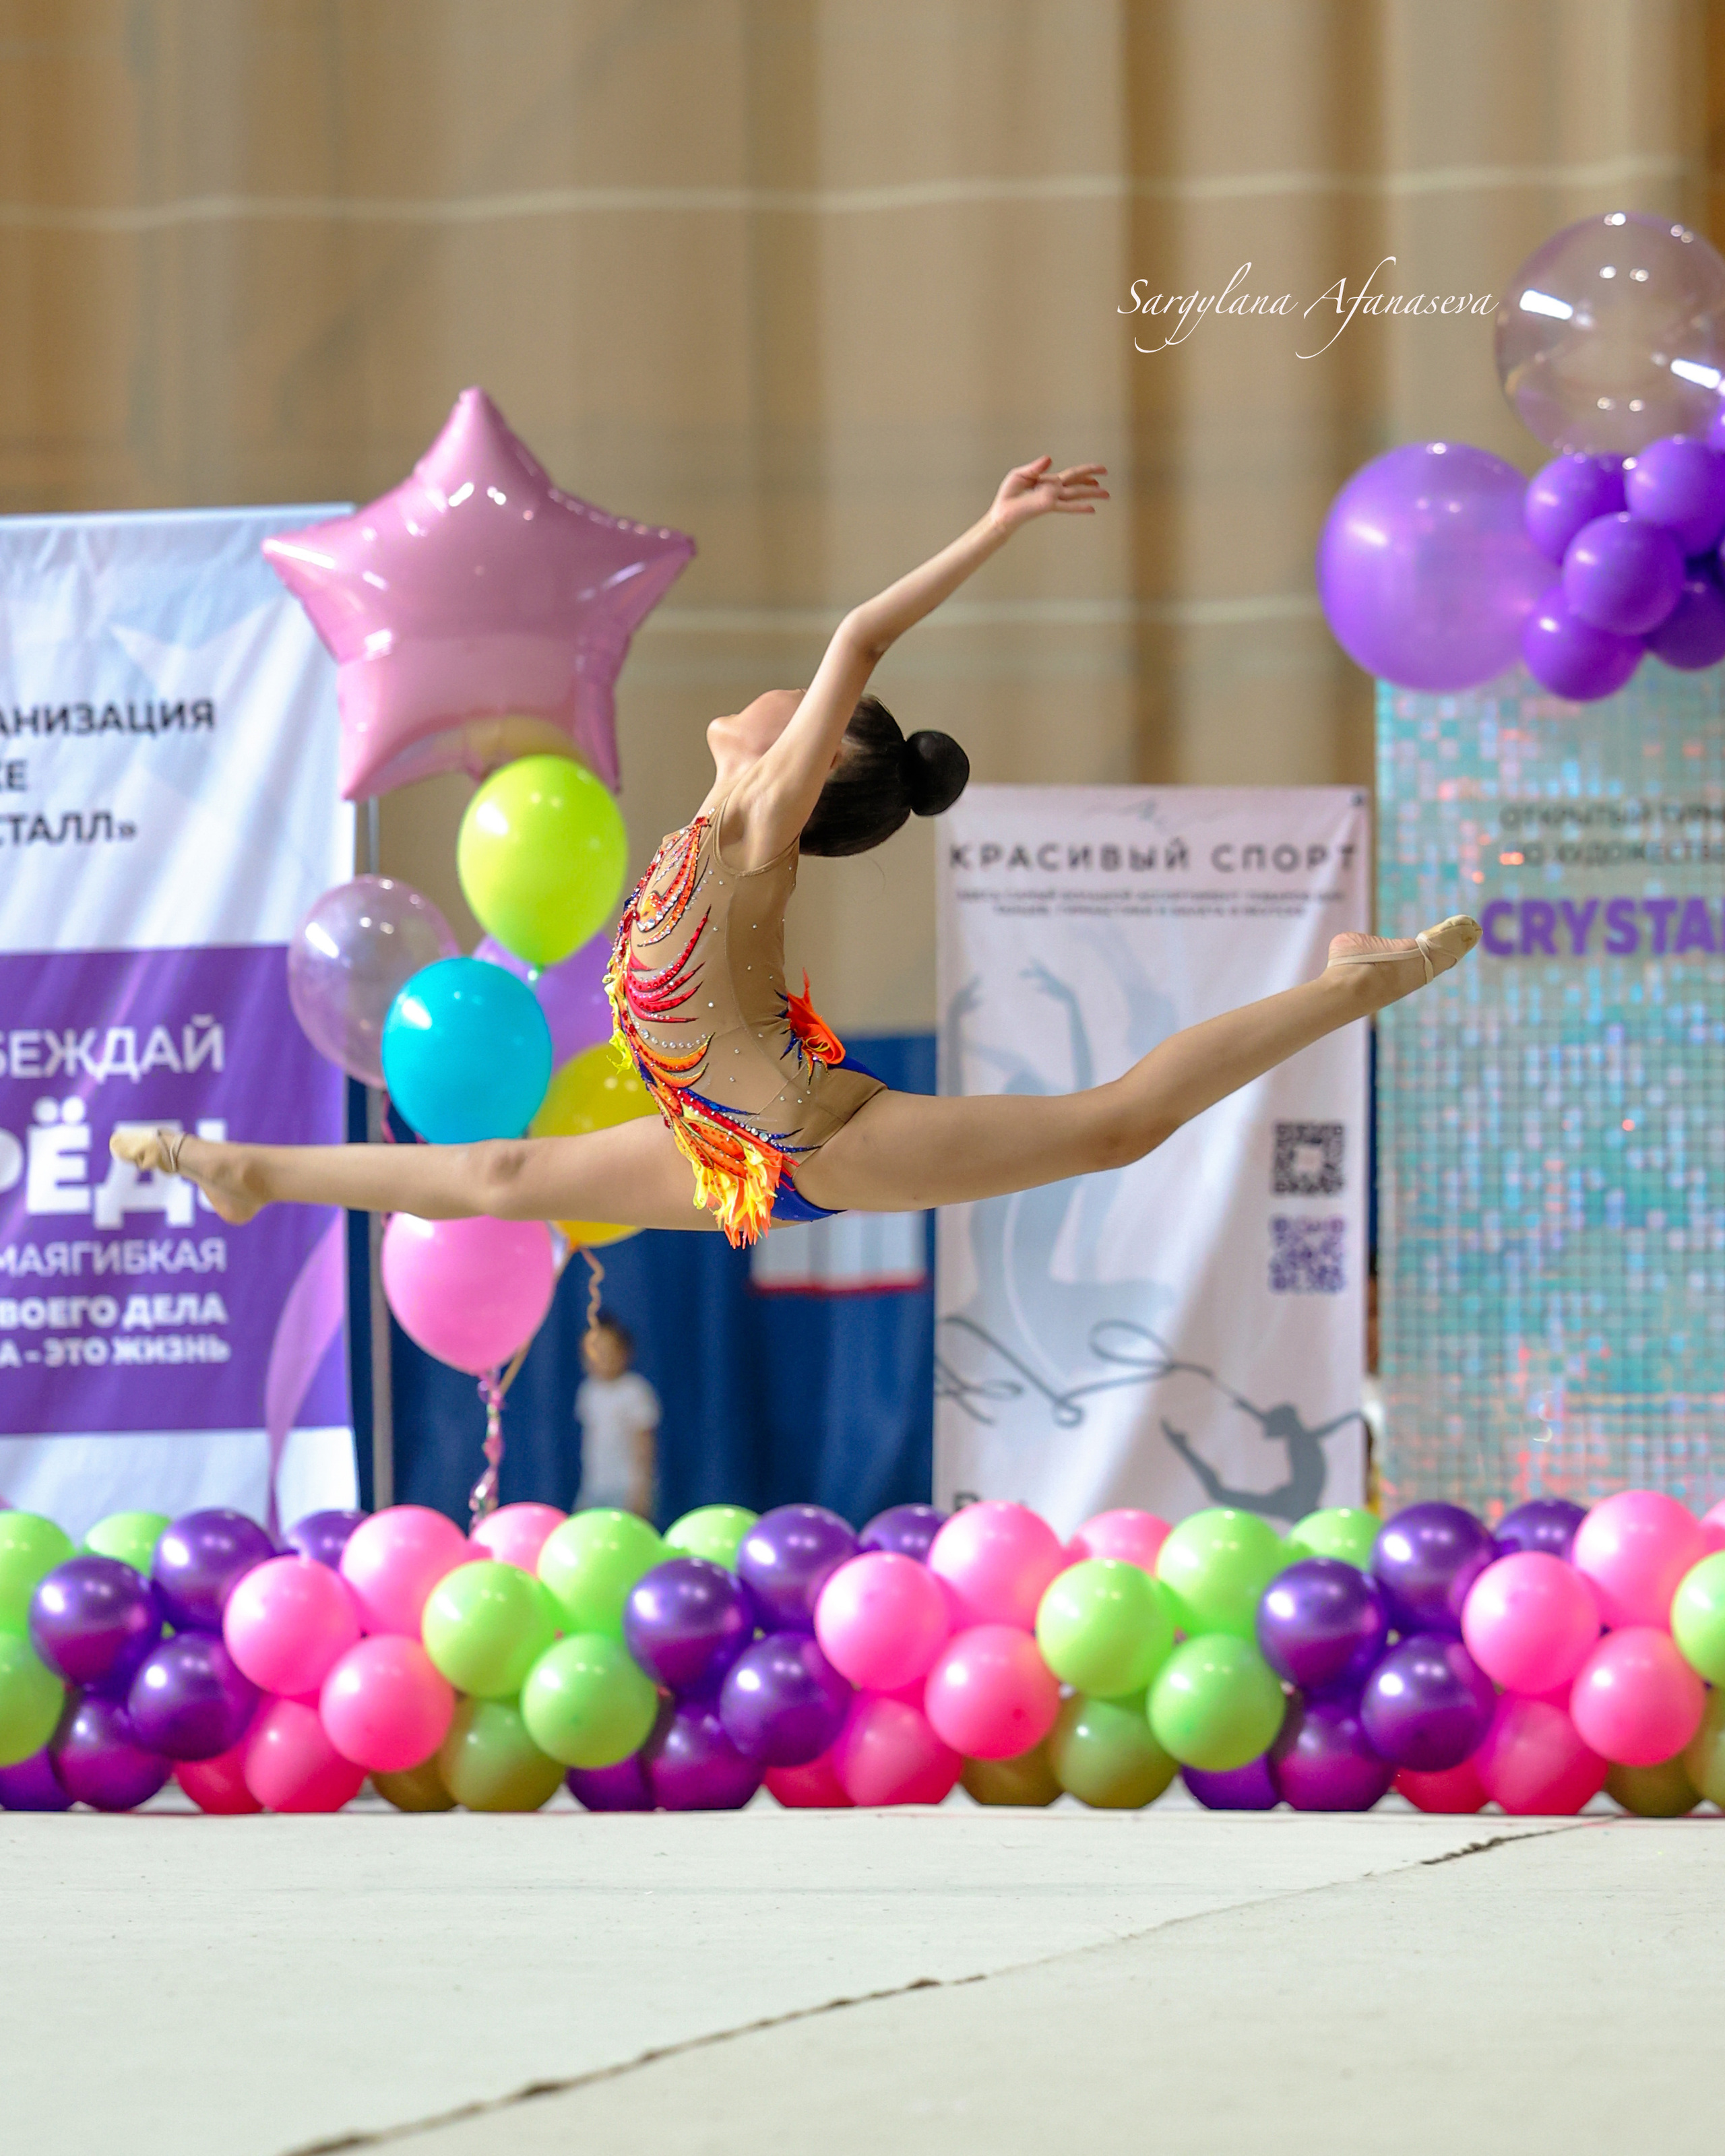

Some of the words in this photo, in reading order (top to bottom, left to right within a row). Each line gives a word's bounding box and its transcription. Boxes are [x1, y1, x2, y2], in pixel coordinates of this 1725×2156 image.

[0, 810, 137, 846] ТАЛЛ»
[949, 836, 1191, 872] КРАСИВЫЙ
[1210, 841, 1357, 873] СПОРТ
[1480, 897, 1725, 956] CRYSTA
[0, 1013, 226, 1083] ЕЖДАЙ
[121, 1292, 228, 1331] ДЕЛА
[43, 1336, 110, 1368] ЭТО
[111, 1333, 232, 1366] ЖИЗНЬ
